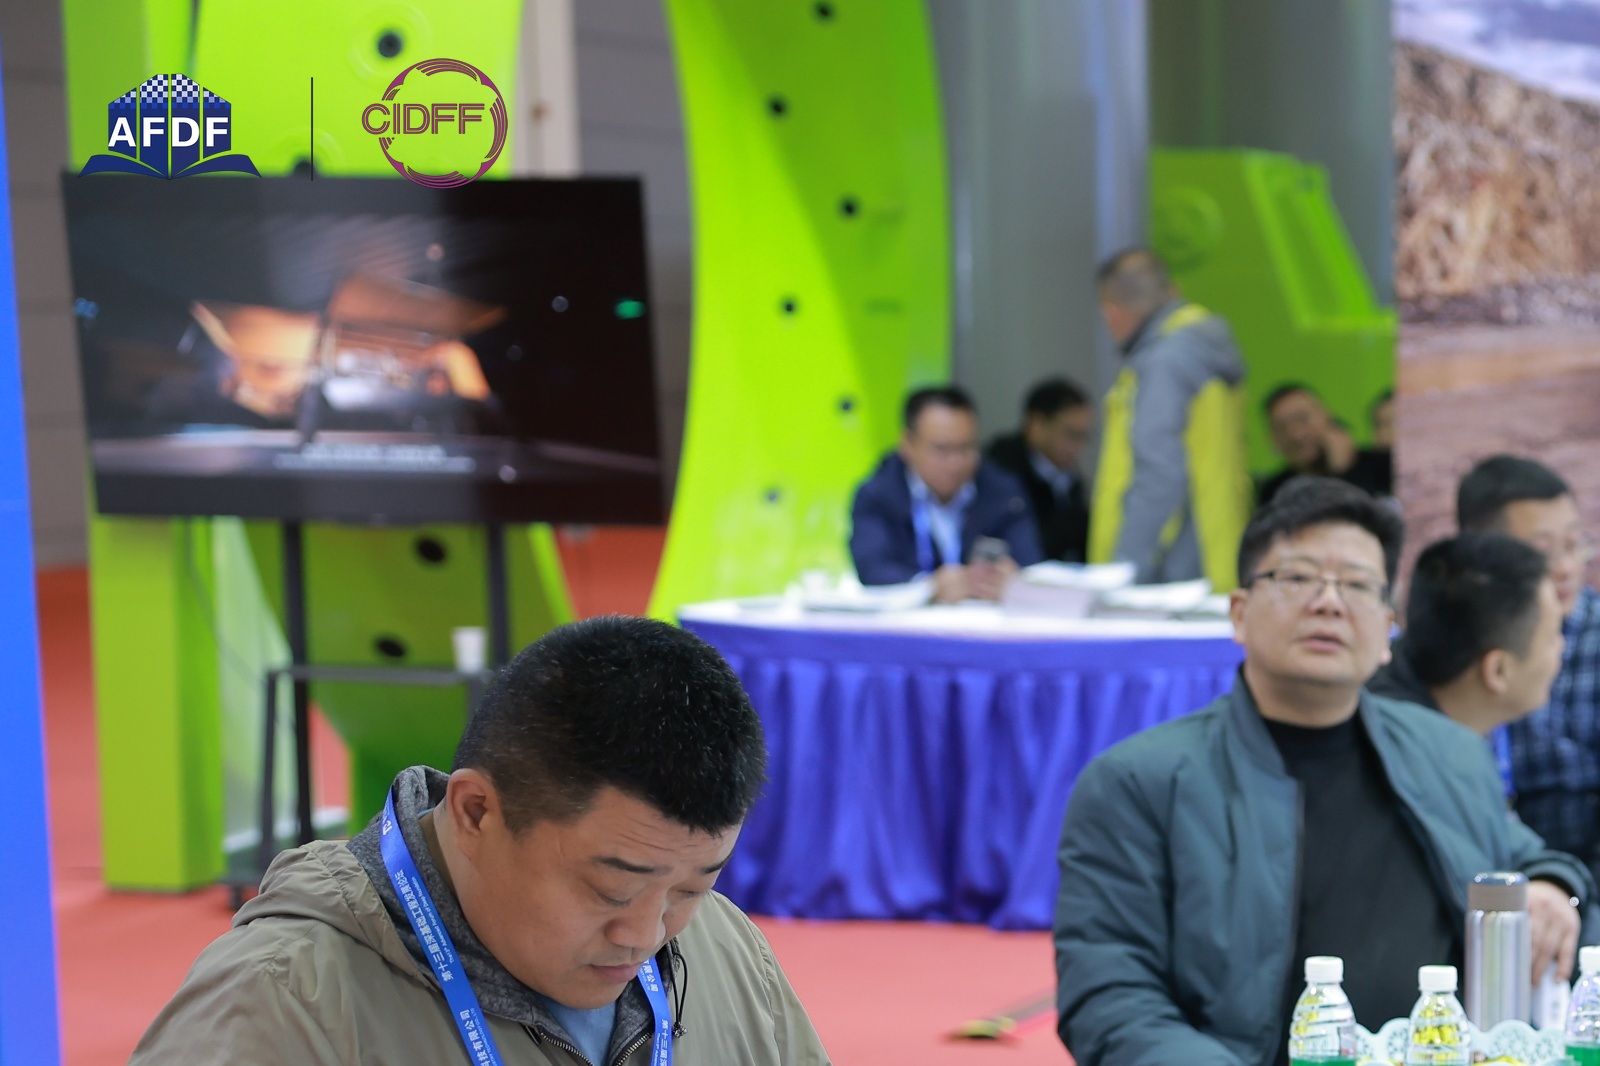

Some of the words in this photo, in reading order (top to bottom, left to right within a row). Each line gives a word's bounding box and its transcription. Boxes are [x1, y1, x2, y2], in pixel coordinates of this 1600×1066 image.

[409, 875, 423, 896] Foundation
[393, 868, 454, 982] 第十三届深基础工程发展论坛
